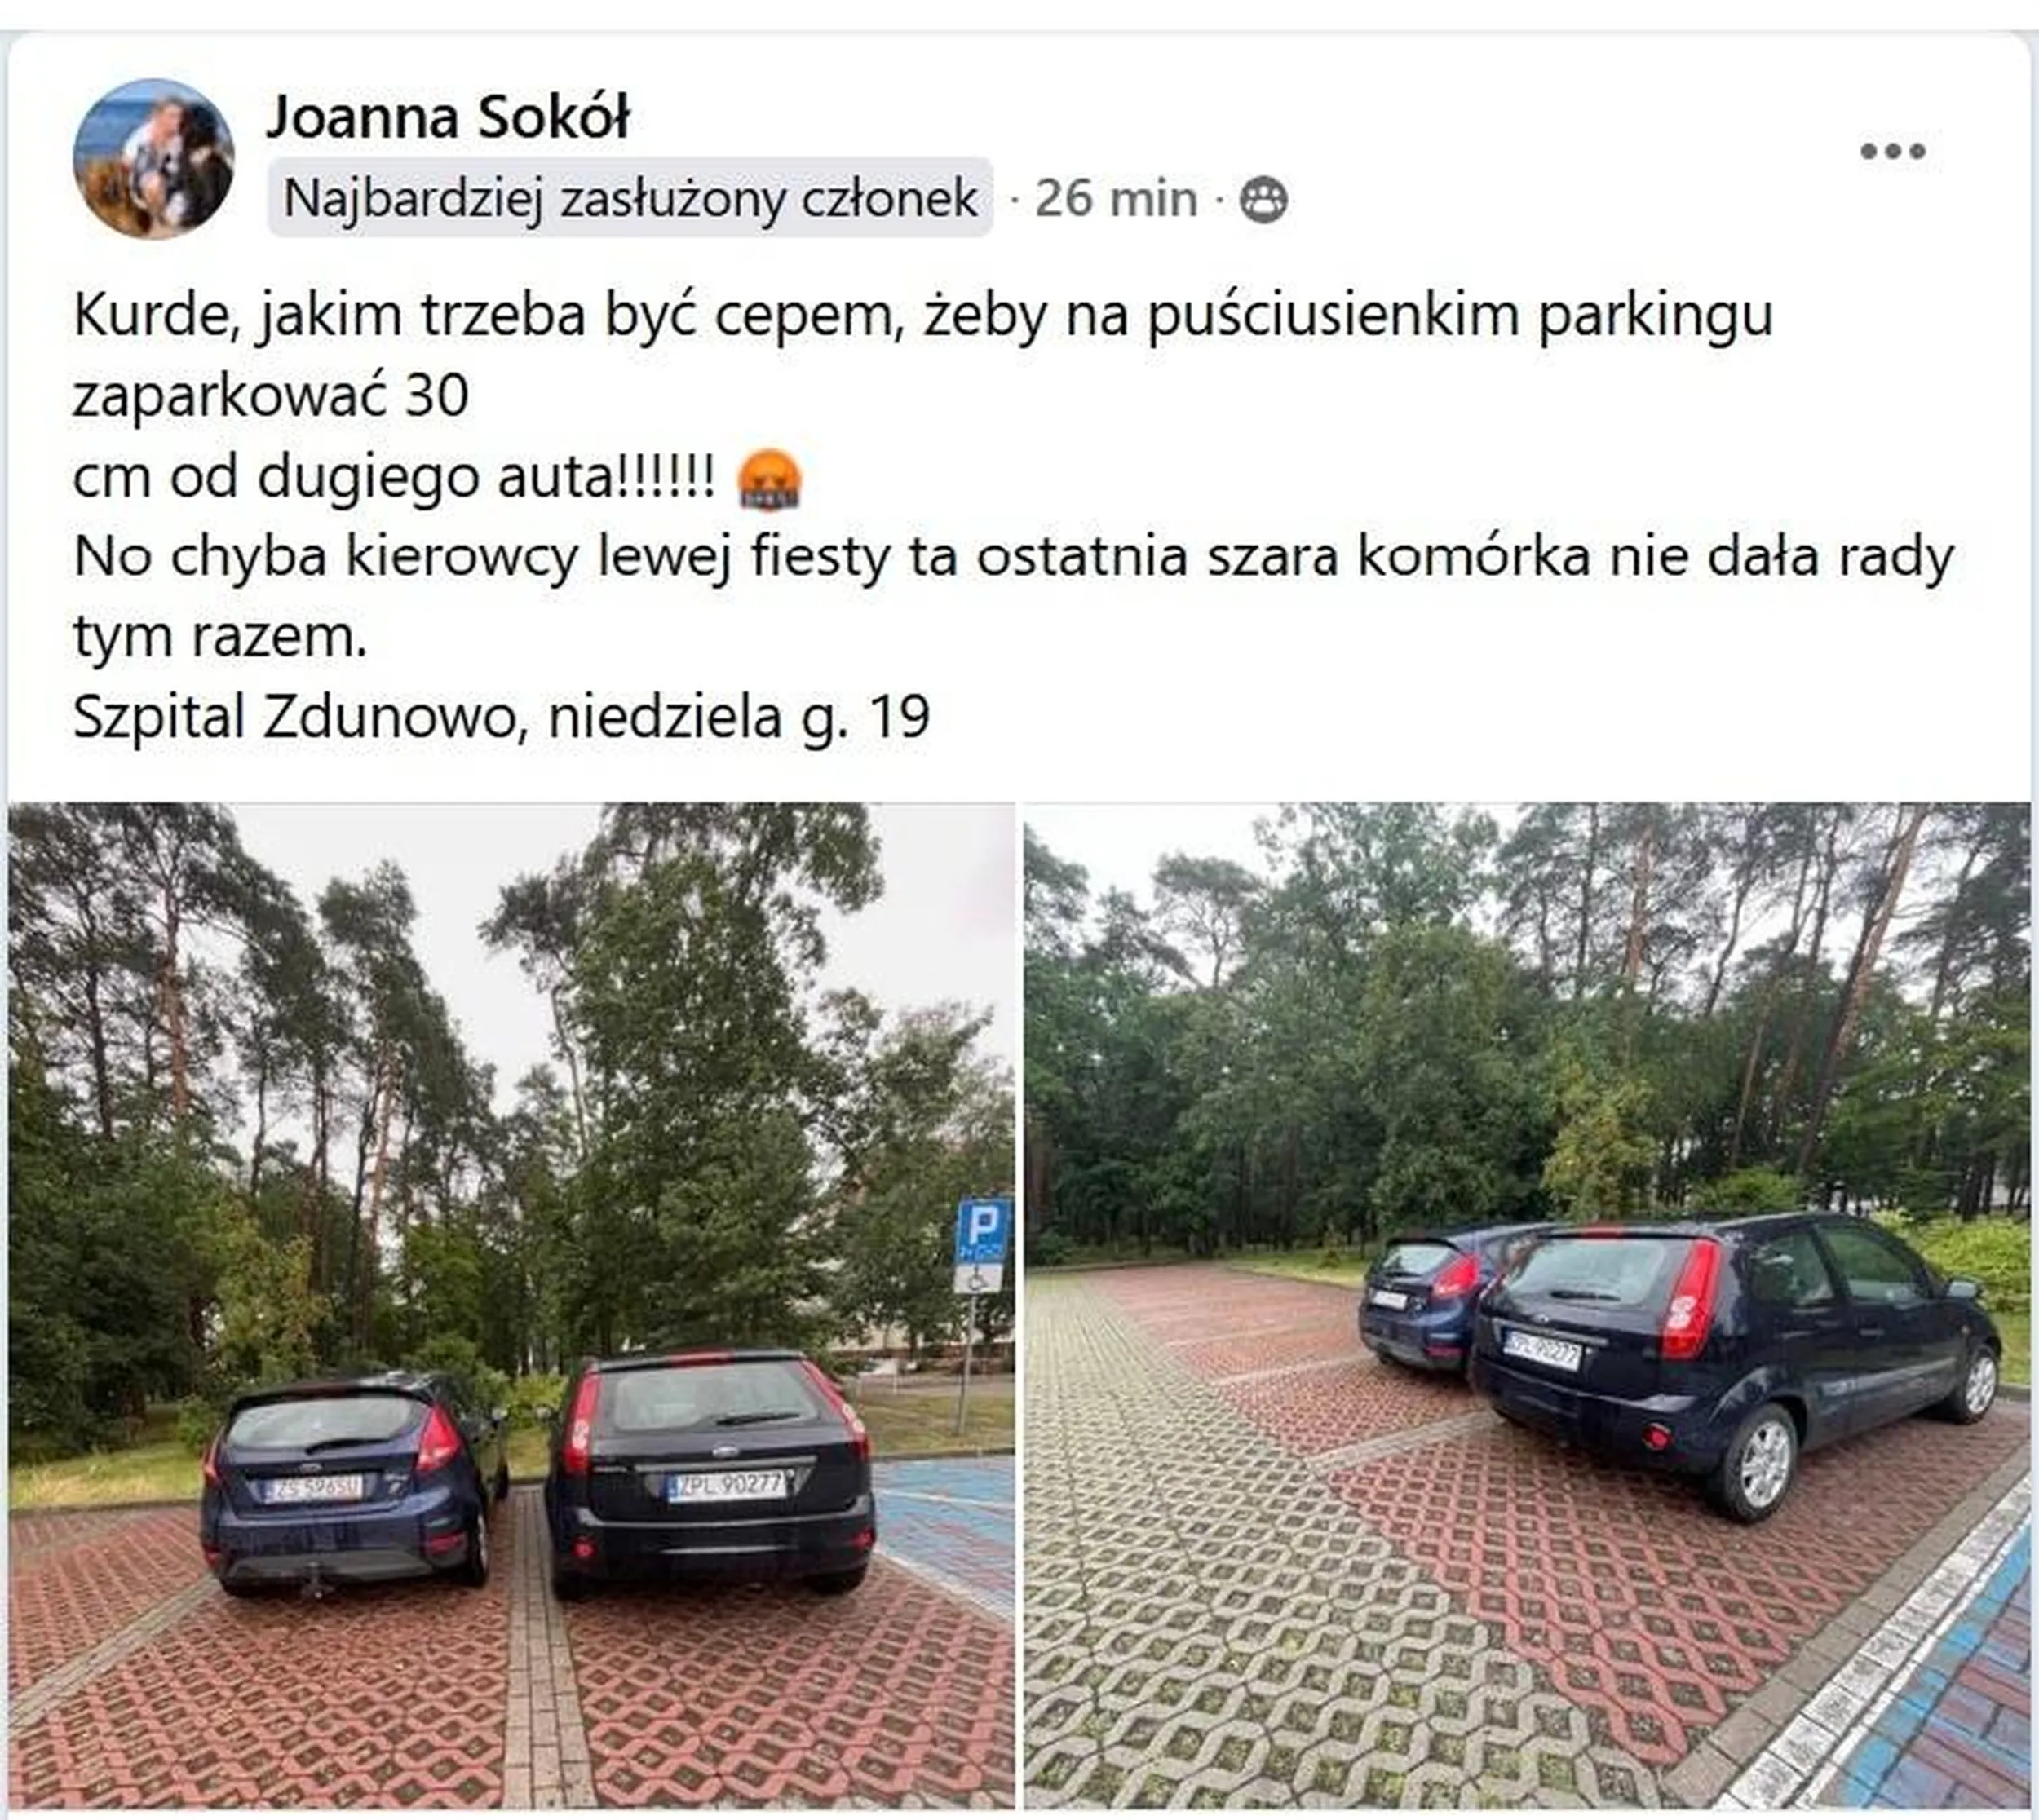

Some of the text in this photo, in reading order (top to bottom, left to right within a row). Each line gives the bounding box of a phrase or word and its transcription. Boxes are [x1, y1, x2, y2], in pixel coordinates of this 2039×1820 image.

[968, 1205, 999, 1245] P
[683, 1472, 782, 1495] ZPL 90277
